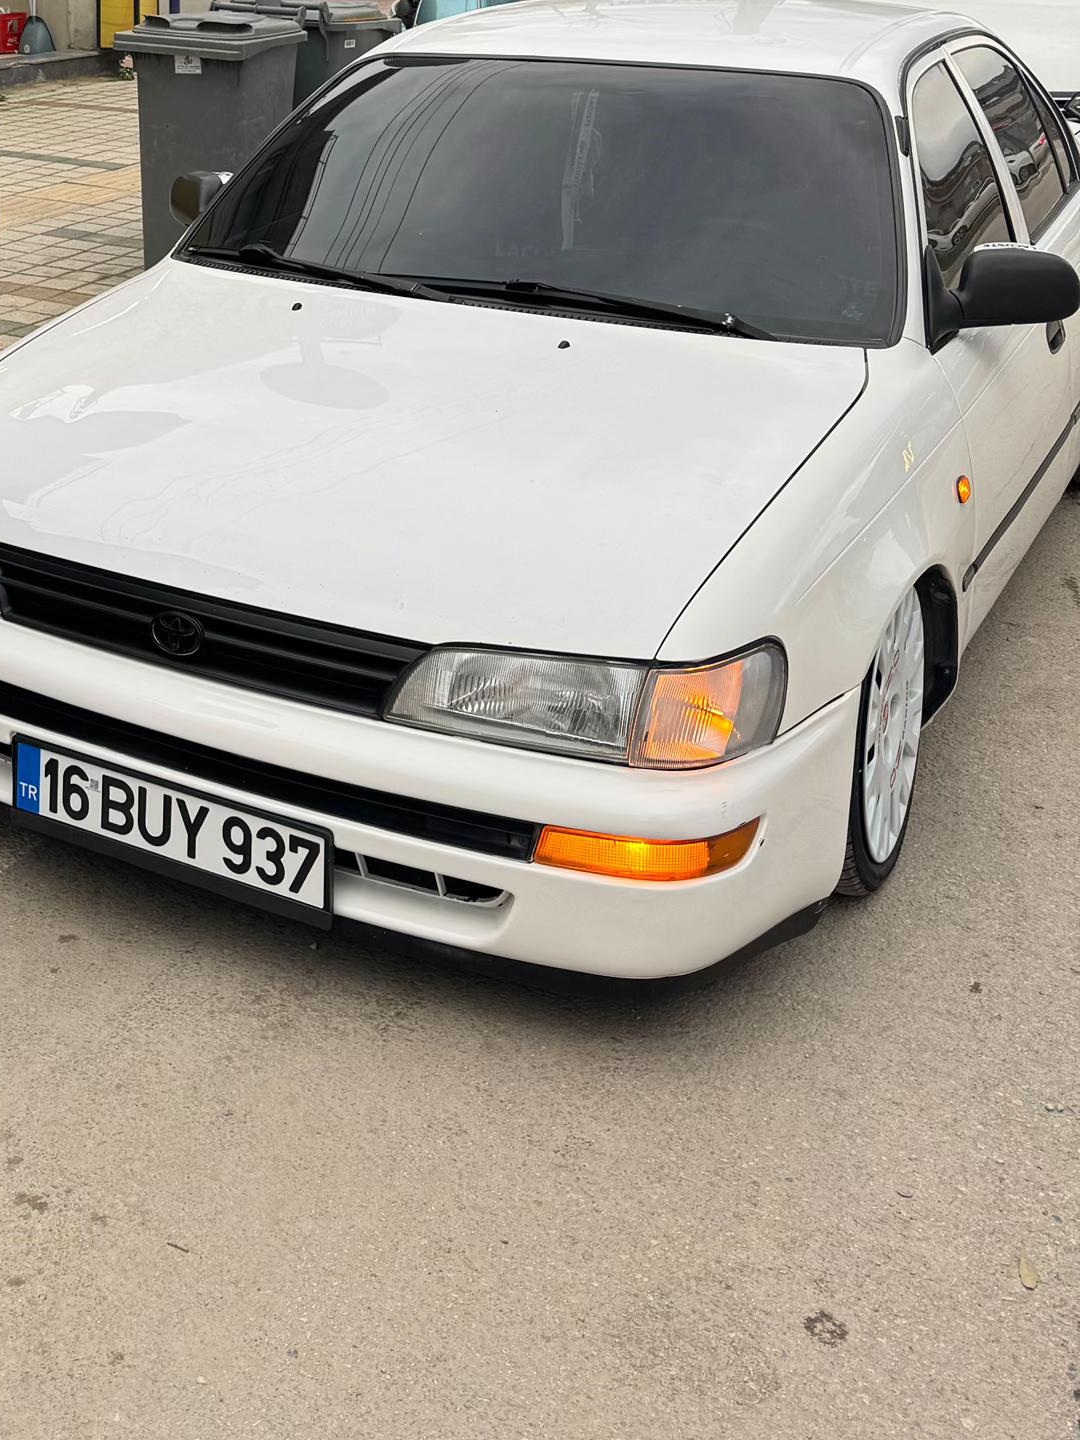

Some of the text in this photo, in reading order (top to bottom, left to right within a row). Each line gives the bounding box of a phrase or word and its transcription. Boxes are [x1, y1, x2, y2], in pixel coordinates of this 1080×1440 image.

[20, 757, 321, 894] TR 16 BUY 937
